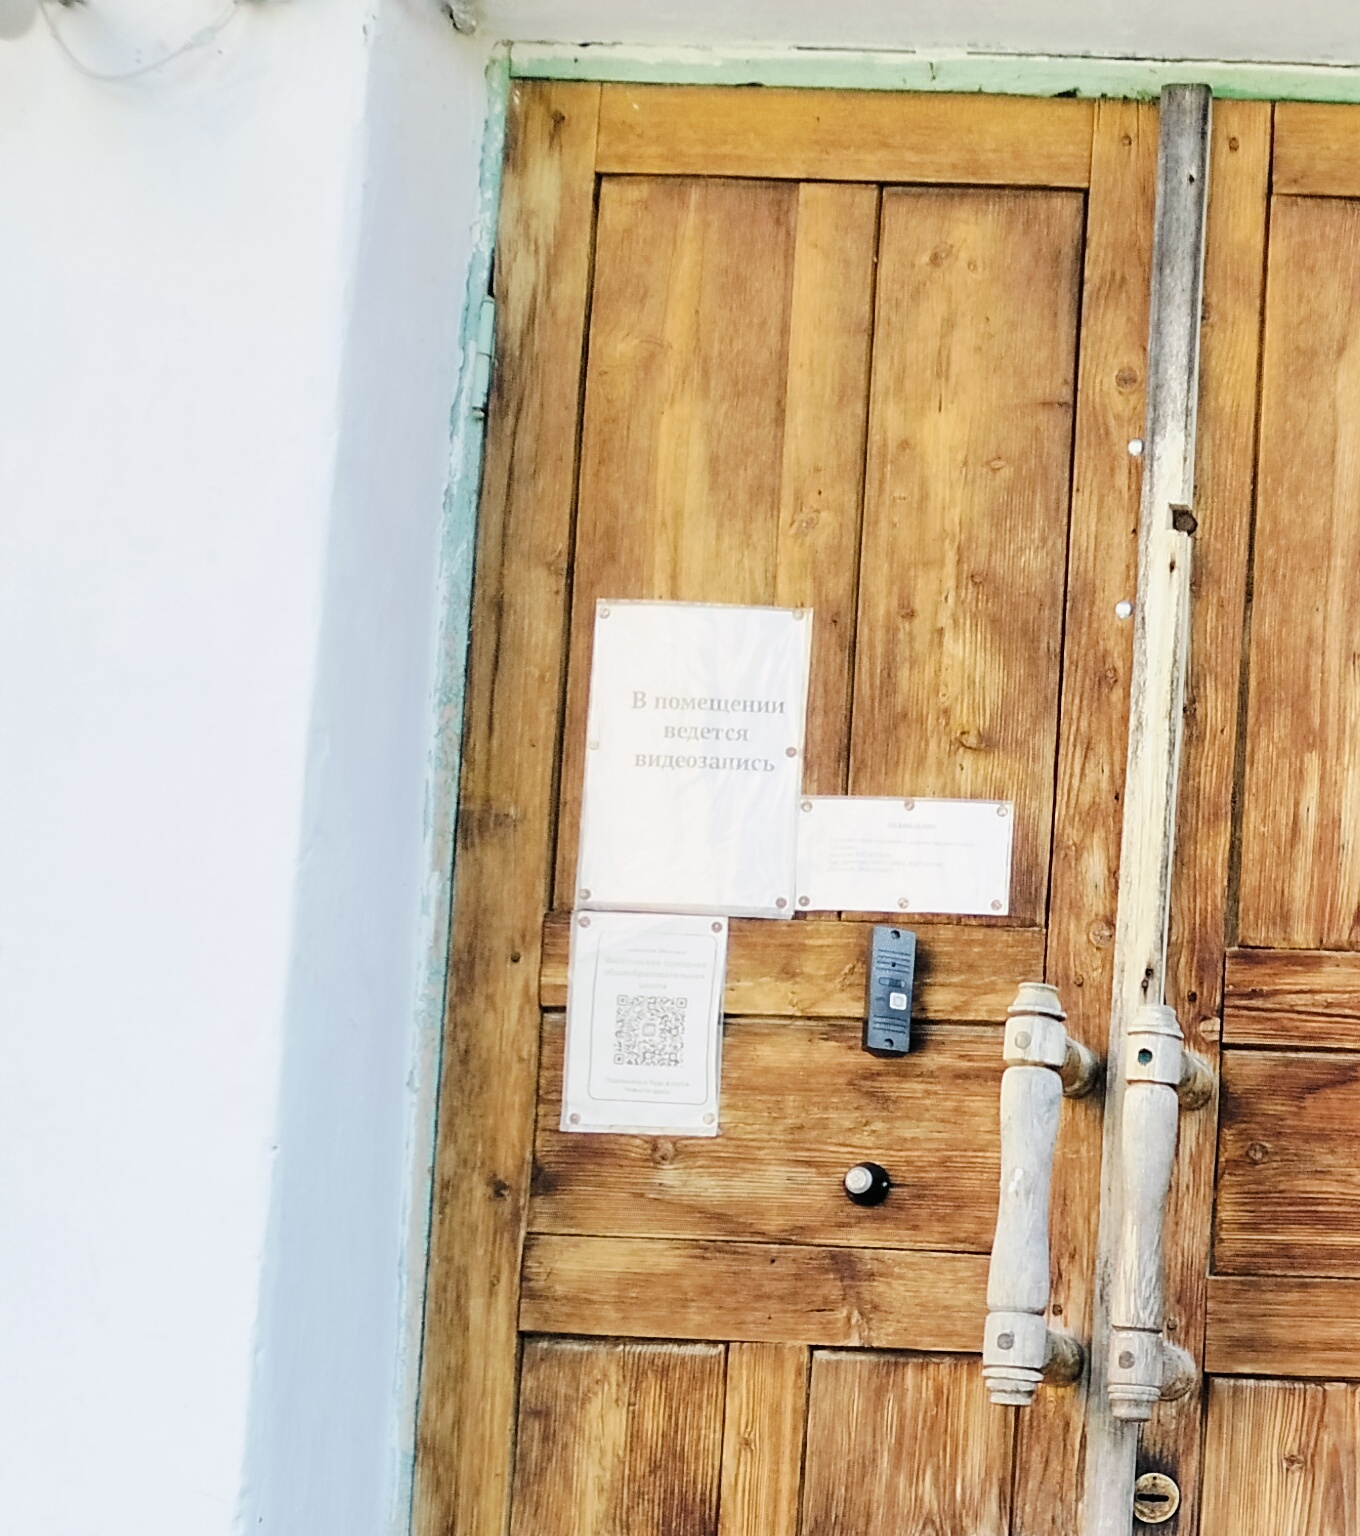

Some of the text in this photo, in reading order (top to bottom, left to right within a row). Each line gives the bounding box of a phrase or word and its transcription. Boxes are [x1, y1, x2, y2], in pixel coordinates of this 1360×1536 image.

[631, 690, 786, 714] В помещении
[663, 725, 749, 742] ведется
[634, 754, 776, 773] видеозапись
